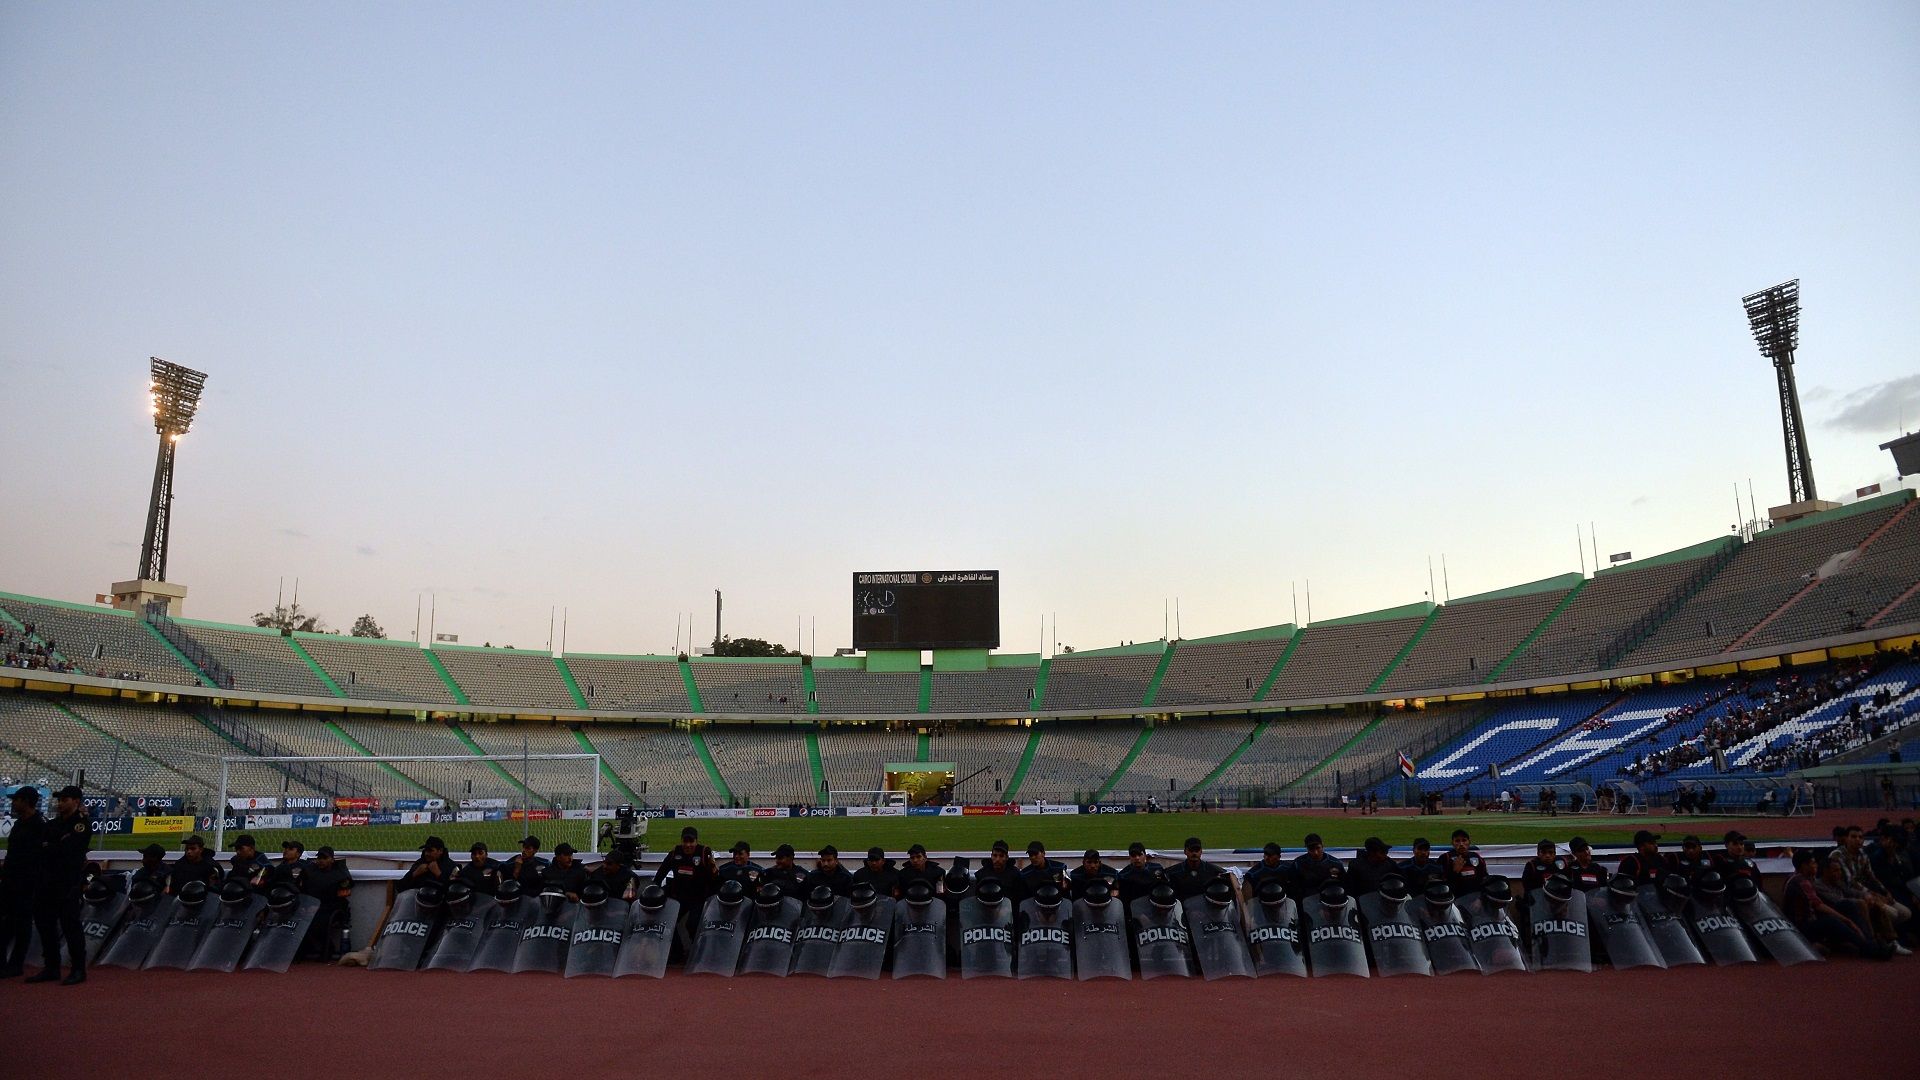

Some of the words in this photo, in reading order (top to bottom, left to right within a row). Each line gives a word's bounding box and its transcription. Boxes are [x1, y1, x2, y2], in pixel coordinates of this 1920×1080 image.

[859, 574, 871, 584] CAIRO
[872, 574, 900, 584] INTERNATIONAL
[901, 573, 917, 584] STADIUM
[286, 798, 326, 808] SAMSUNG
[811, 807, 836, 816] pepsi
[1100, 805, 1126, 814] pepsi
[213, 816, 237, 831] ppsi
[384, 921, 428, 937] POLICE
[523, 924, 571, 941] POLICE
[573, 928, 621, 945] POLICE
[747, 925, 792, 943] POLICE
[796, 925, 840, 943] POLICE
[840, 926, 886, 943] POLICE
[963, 928, 1012, 944] POLICE
[1021, 928, 1070, 945] POLICE
[1139, 927, 1187, 945] POLICE
[1250, 927, 1299, 944] POLICE
[1311, 926, 1361, 943] POLICE
[1371, 924, 1422, 941] POLICE
[1424, 923, 1468, 941] POLIC
[1534, 919, 1586, 937] POLICE
